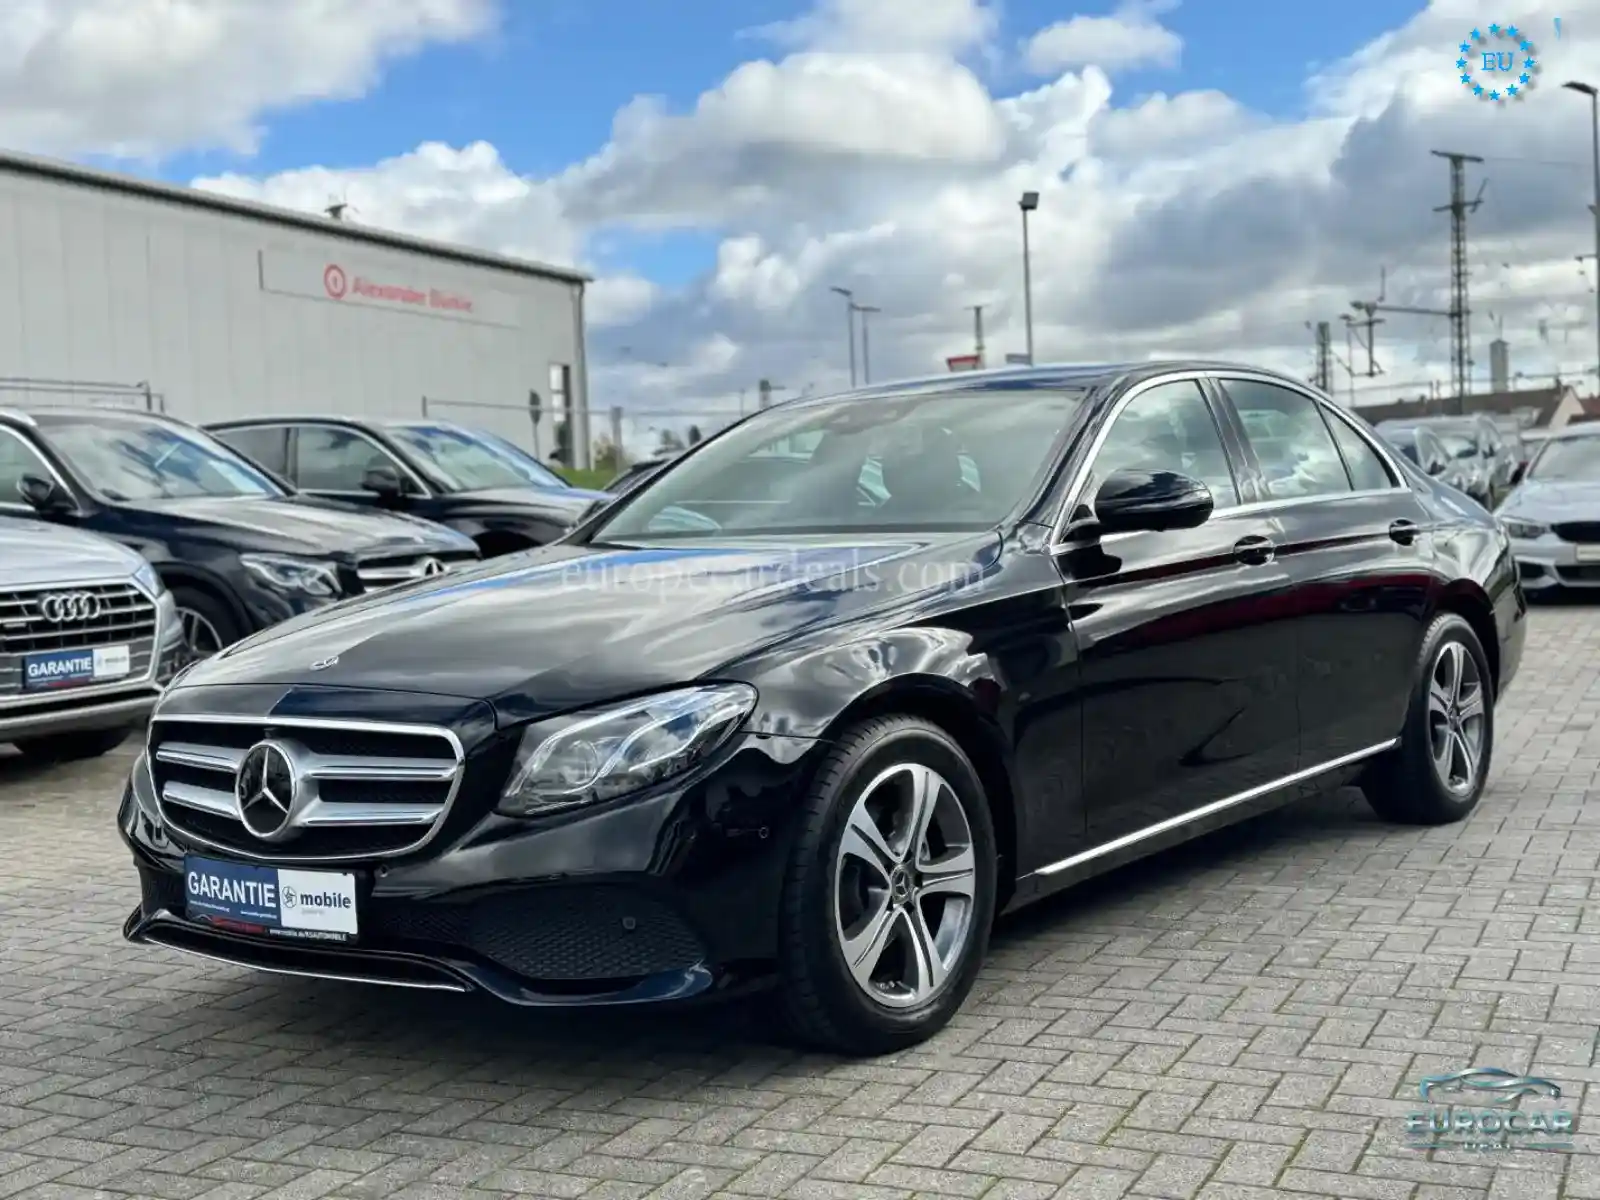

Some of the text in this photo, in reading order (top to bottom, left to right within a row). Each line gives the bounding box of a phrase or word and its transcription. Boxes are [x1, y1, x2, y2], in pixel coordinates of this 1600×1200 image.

[28, 656, 92, 677] GARANTIE
[187, 871, 277, 908] GARANTIE
[299, 892, 352, 909] mobile
